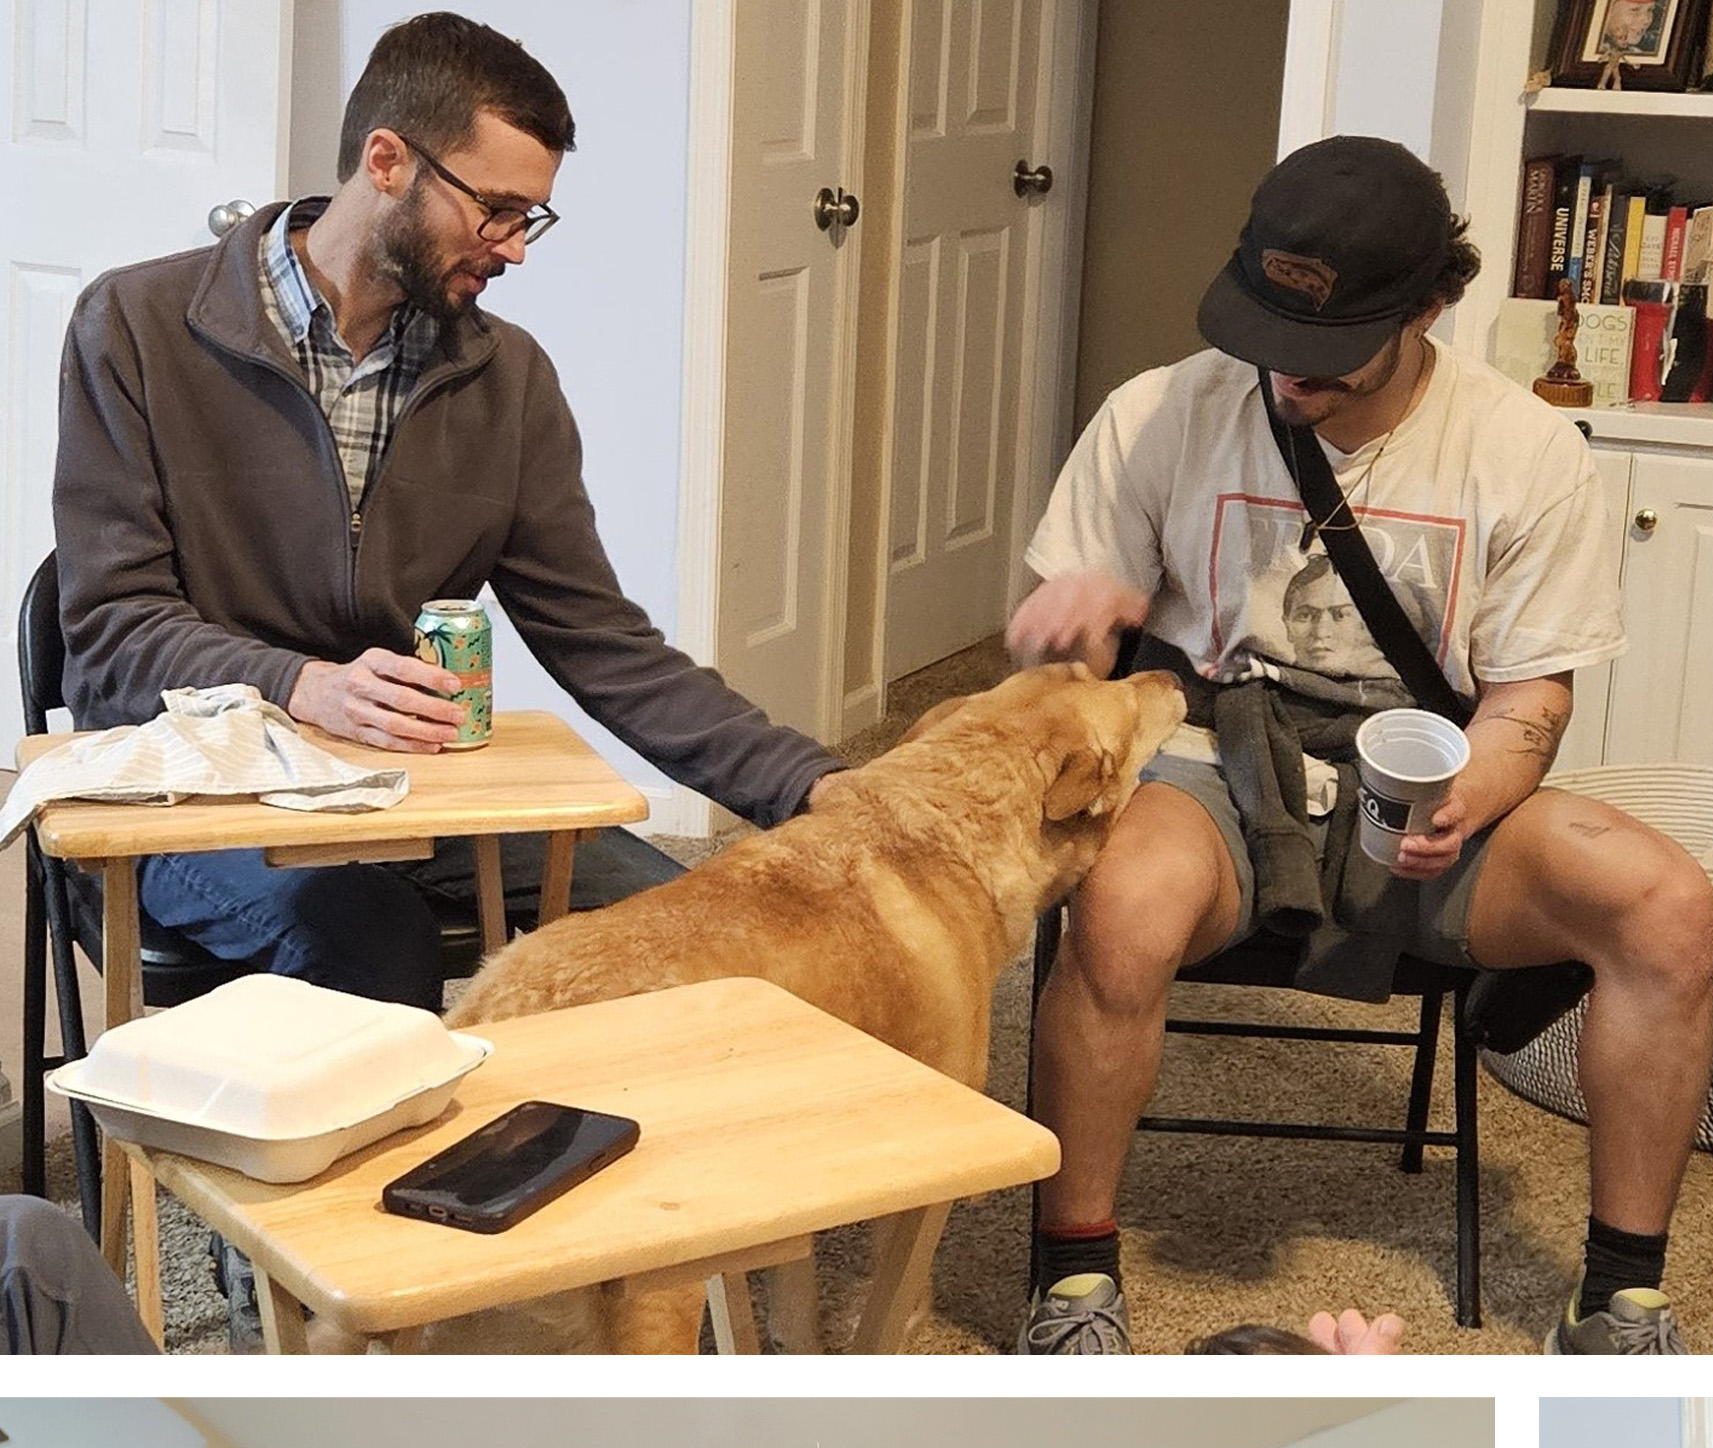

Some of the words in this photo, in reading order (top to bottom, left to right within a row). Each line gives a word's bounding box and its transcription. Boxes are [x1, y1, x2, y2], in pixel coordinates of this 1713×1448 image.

[1550, 207, 1570, 272] UNIVERSE
[1584, 228, 1598, 279] WEBER'S
[1670, 227, 1680, 259] MICHAEL
